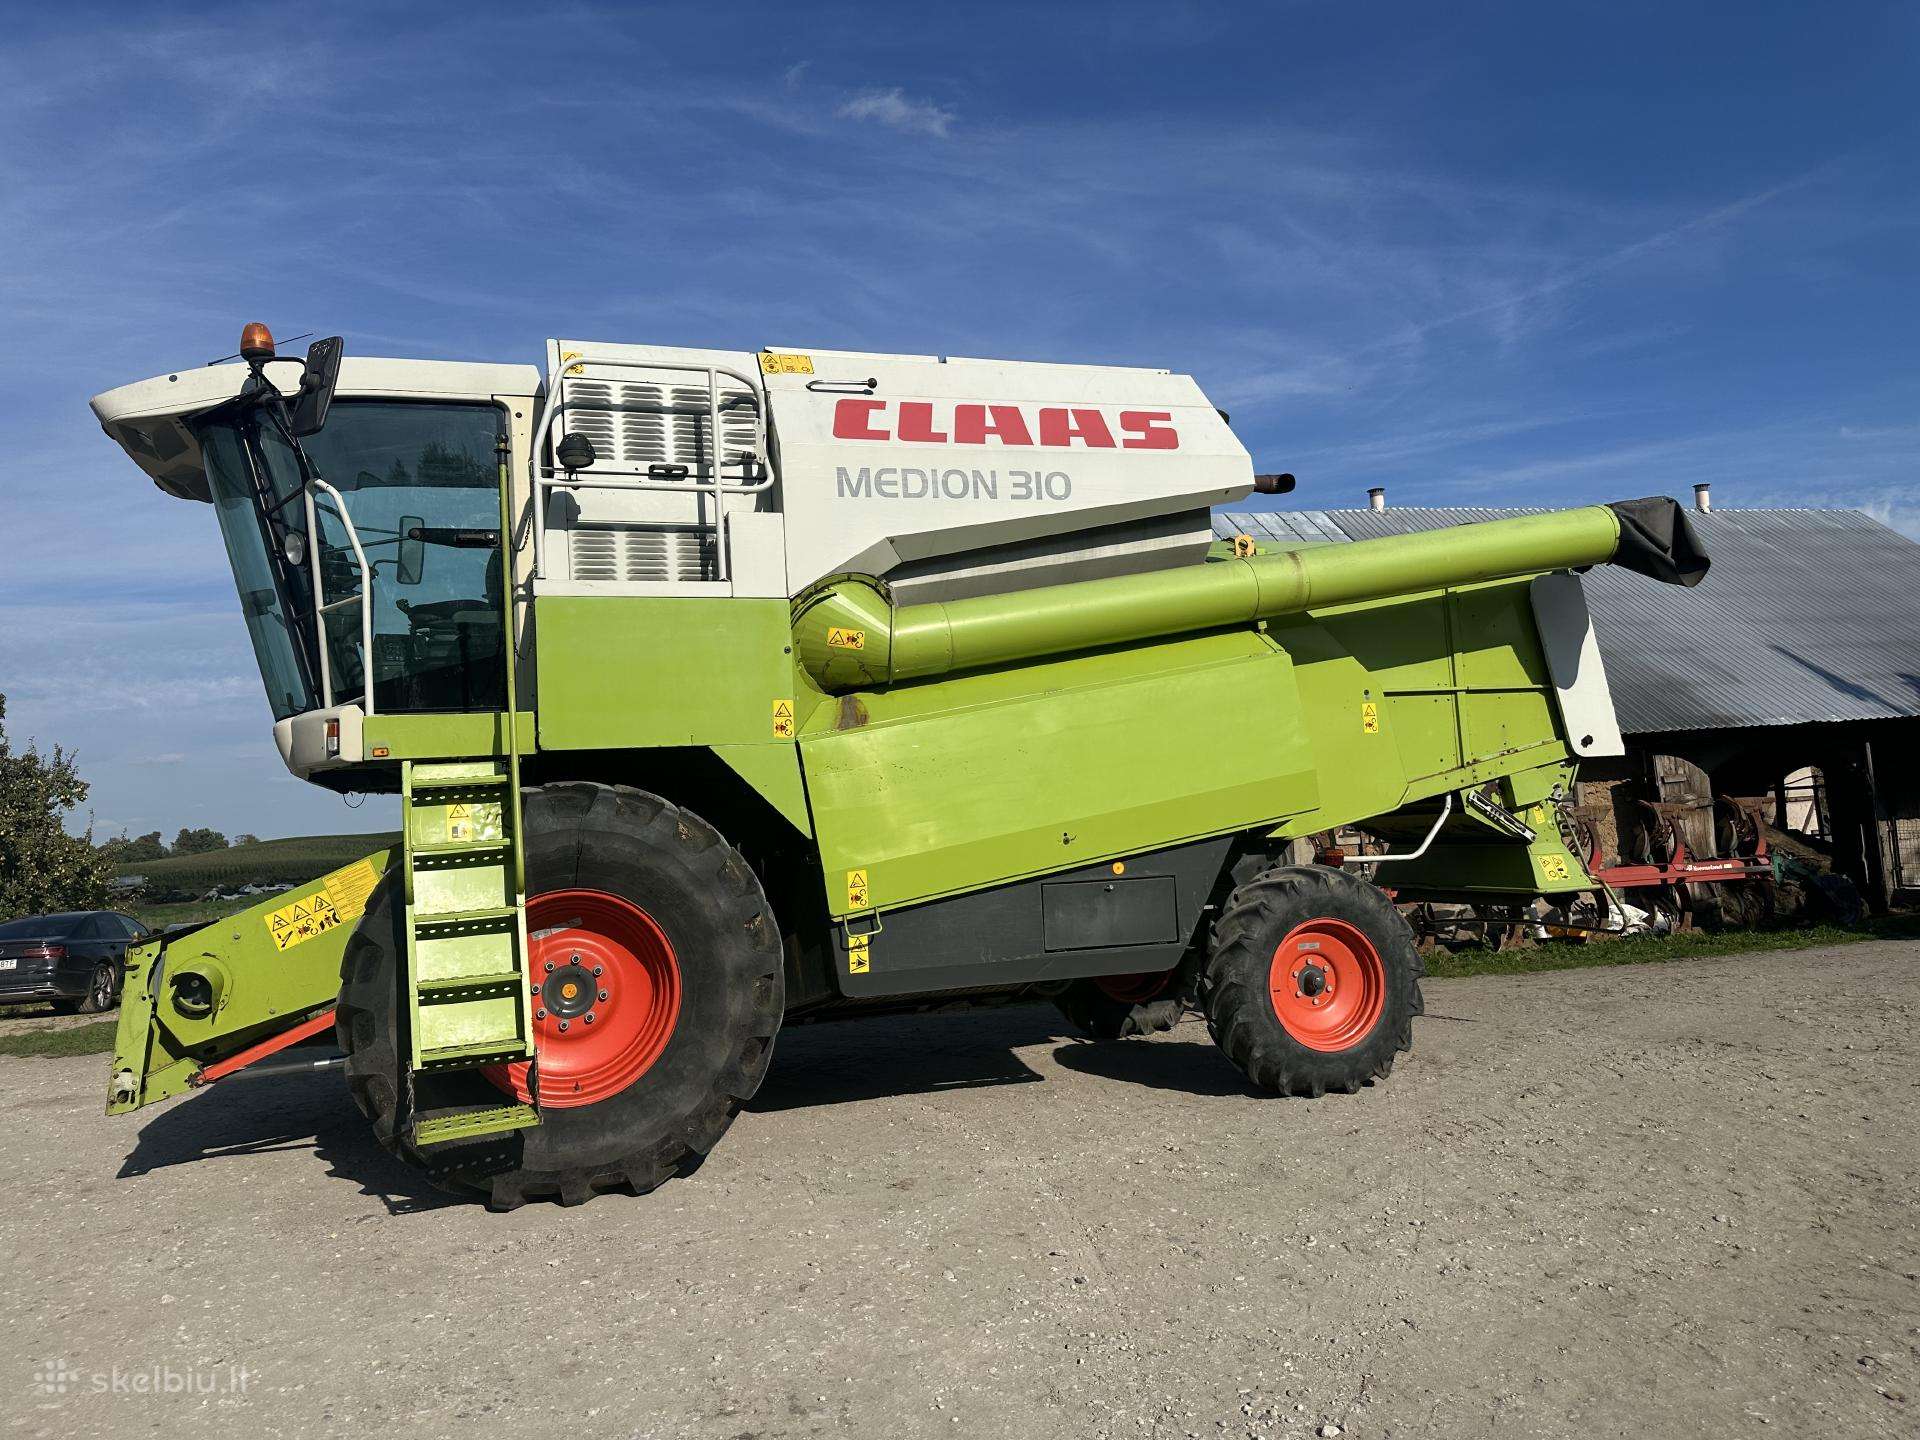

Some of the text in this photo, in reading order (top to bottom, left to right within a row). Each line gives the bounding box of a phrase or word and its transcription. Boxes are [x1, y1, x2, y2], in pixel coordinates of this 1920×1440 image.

[833, 398, 1180, 450] CLAAS
[836, 466, 1072, 501] MEDION 310
